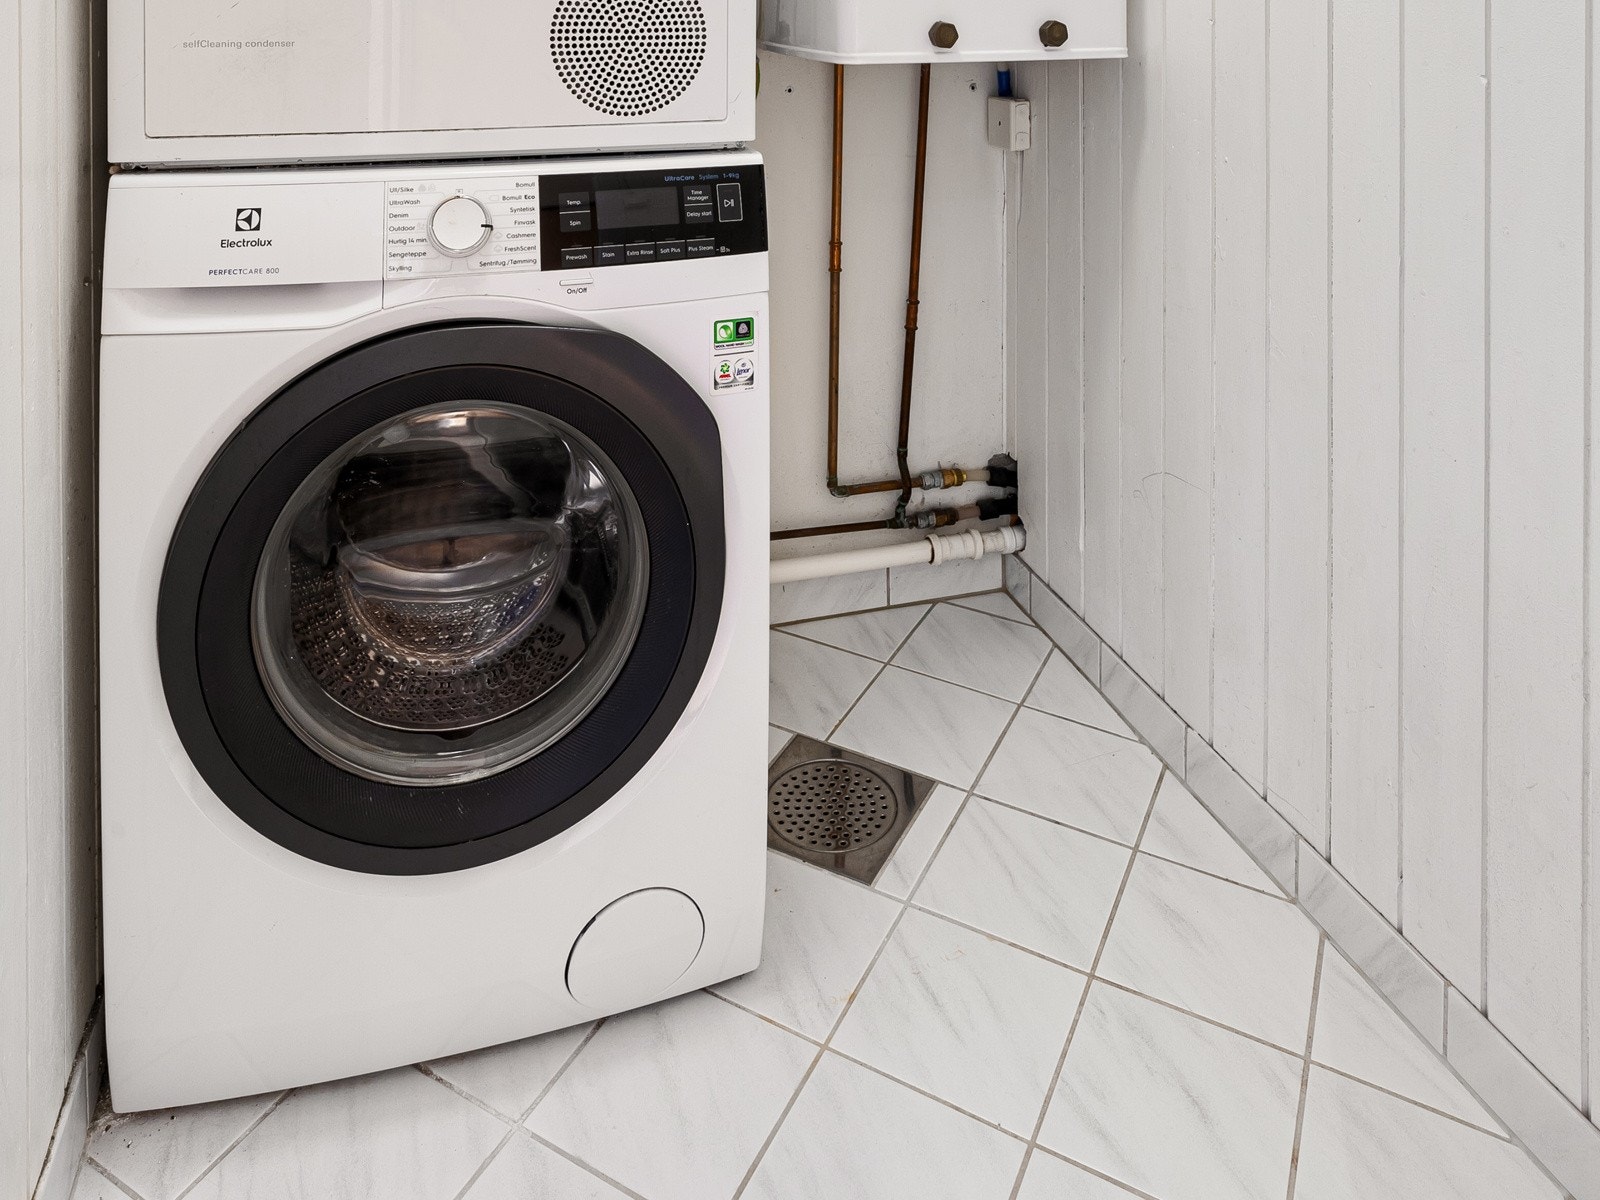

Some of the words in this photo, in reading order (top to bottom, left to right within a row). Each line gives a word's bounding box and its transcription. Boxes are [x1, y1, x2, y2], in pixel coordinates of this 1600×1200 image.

[182, 40, 242, 49] selfCleaning
[245, 40, 295, 48] condenser
[664, 174, 696, 183] UltraCare
[698, 173, 720, 181] System
[389, 186, 415, 194] Ull/Silke
[502, 194, 523, 202] Bomull
[687, 194, 710, 202] Manager
[509, 206, 536, 214] Syntetisk
[686, 210, 701, 218] Delay
[220, 238, 273, 248] Electrolux
[388, 251, 428, 259] Sengeteppe
[208, 268, 263, 276] PERFECTCARE
[265, 267, 280, 275] 800
[566, 287, 588, 295] On/Off
